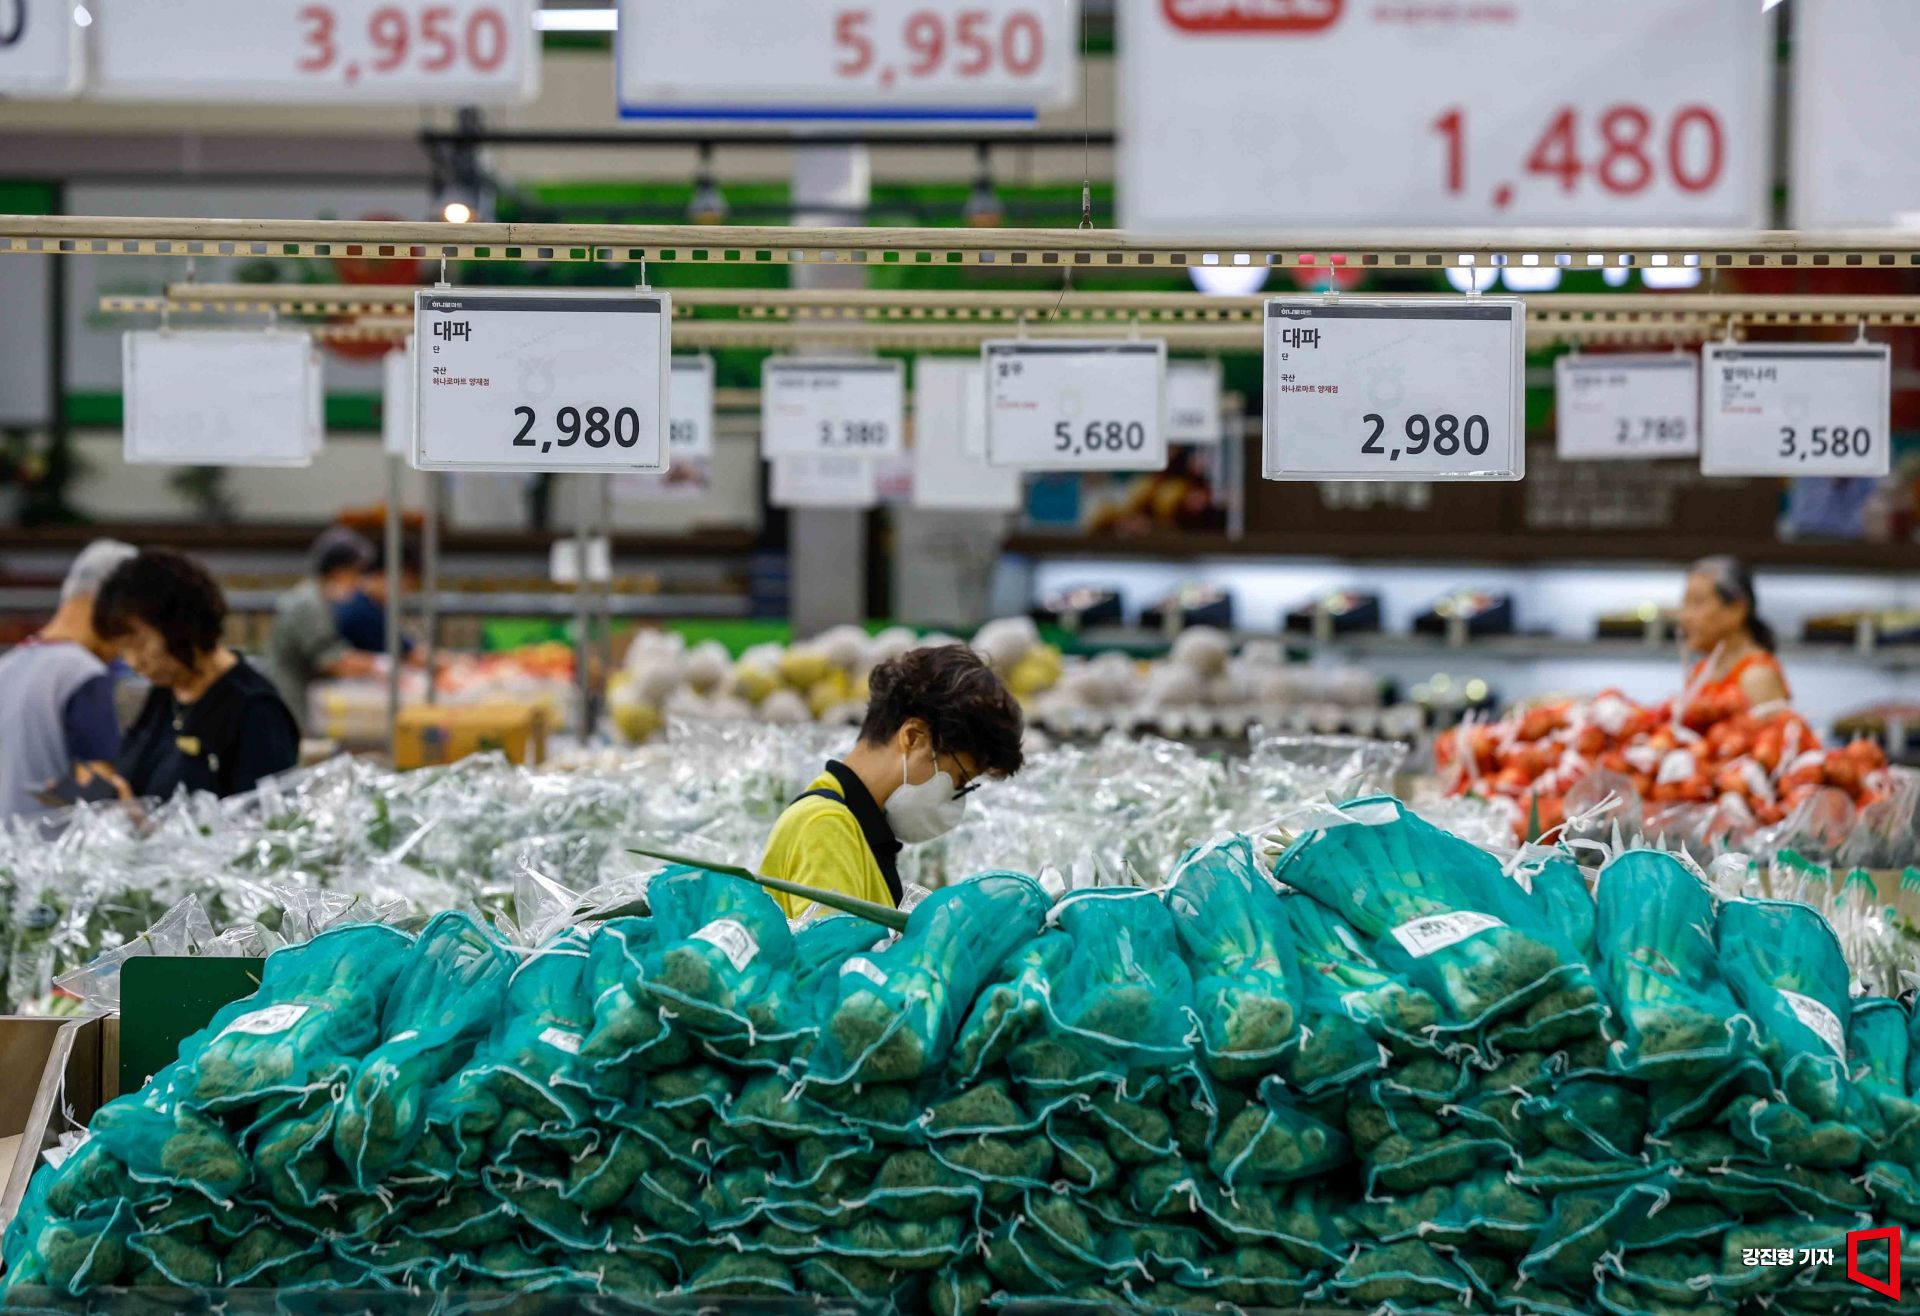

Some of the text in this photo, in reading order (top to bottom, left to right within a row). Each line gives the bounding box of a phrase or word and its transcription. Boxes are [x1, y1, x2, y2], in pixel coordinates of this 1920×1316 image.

[297, 6, 509, 85] 3,950
[833, 9, 1044, 88] 5,950
[1429, 102, 1725, 213] 1,480
[433, 320, 472, 342] 대파
[1282, 328, 1321, 349] 대파
[432, 344, 441, 354] 단
[1281, 352, 1289, 361] 단
[432, 366, 447, 375] 국산
[1281, 373, 1296, 383] 국산
[432, 377, 490, 387] 하나로마트 양재점
[1281, 384, 1339, 394] 하나로마트 양재점
[512, 405, 640, 454] 2,980
[1054, 421, 1145, 456] 5,680
[1361, 413, 1490, 461] 2,980
[1779, 426, 1871, 462] 3,580
